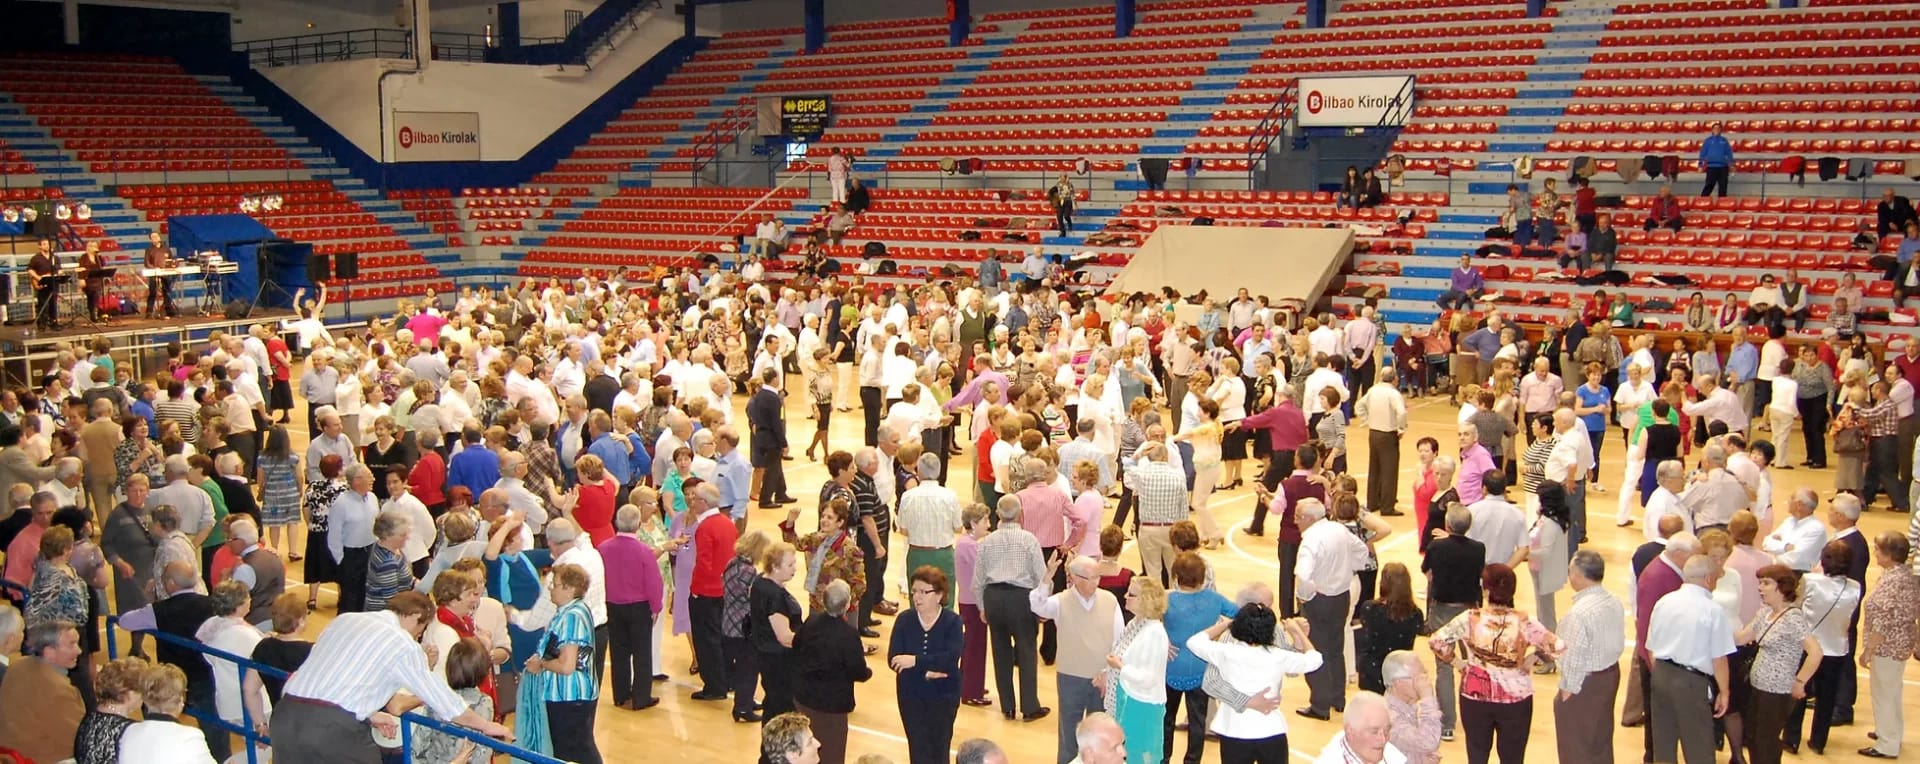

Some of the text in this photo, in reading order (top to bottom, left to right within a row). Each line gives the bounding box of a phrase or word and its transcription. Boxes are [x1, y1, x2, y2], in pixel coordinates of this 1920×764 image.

[1308, 93, 1354, 111] Bilbao
[400, 128, 477, 146] Bilbao Kirolak
